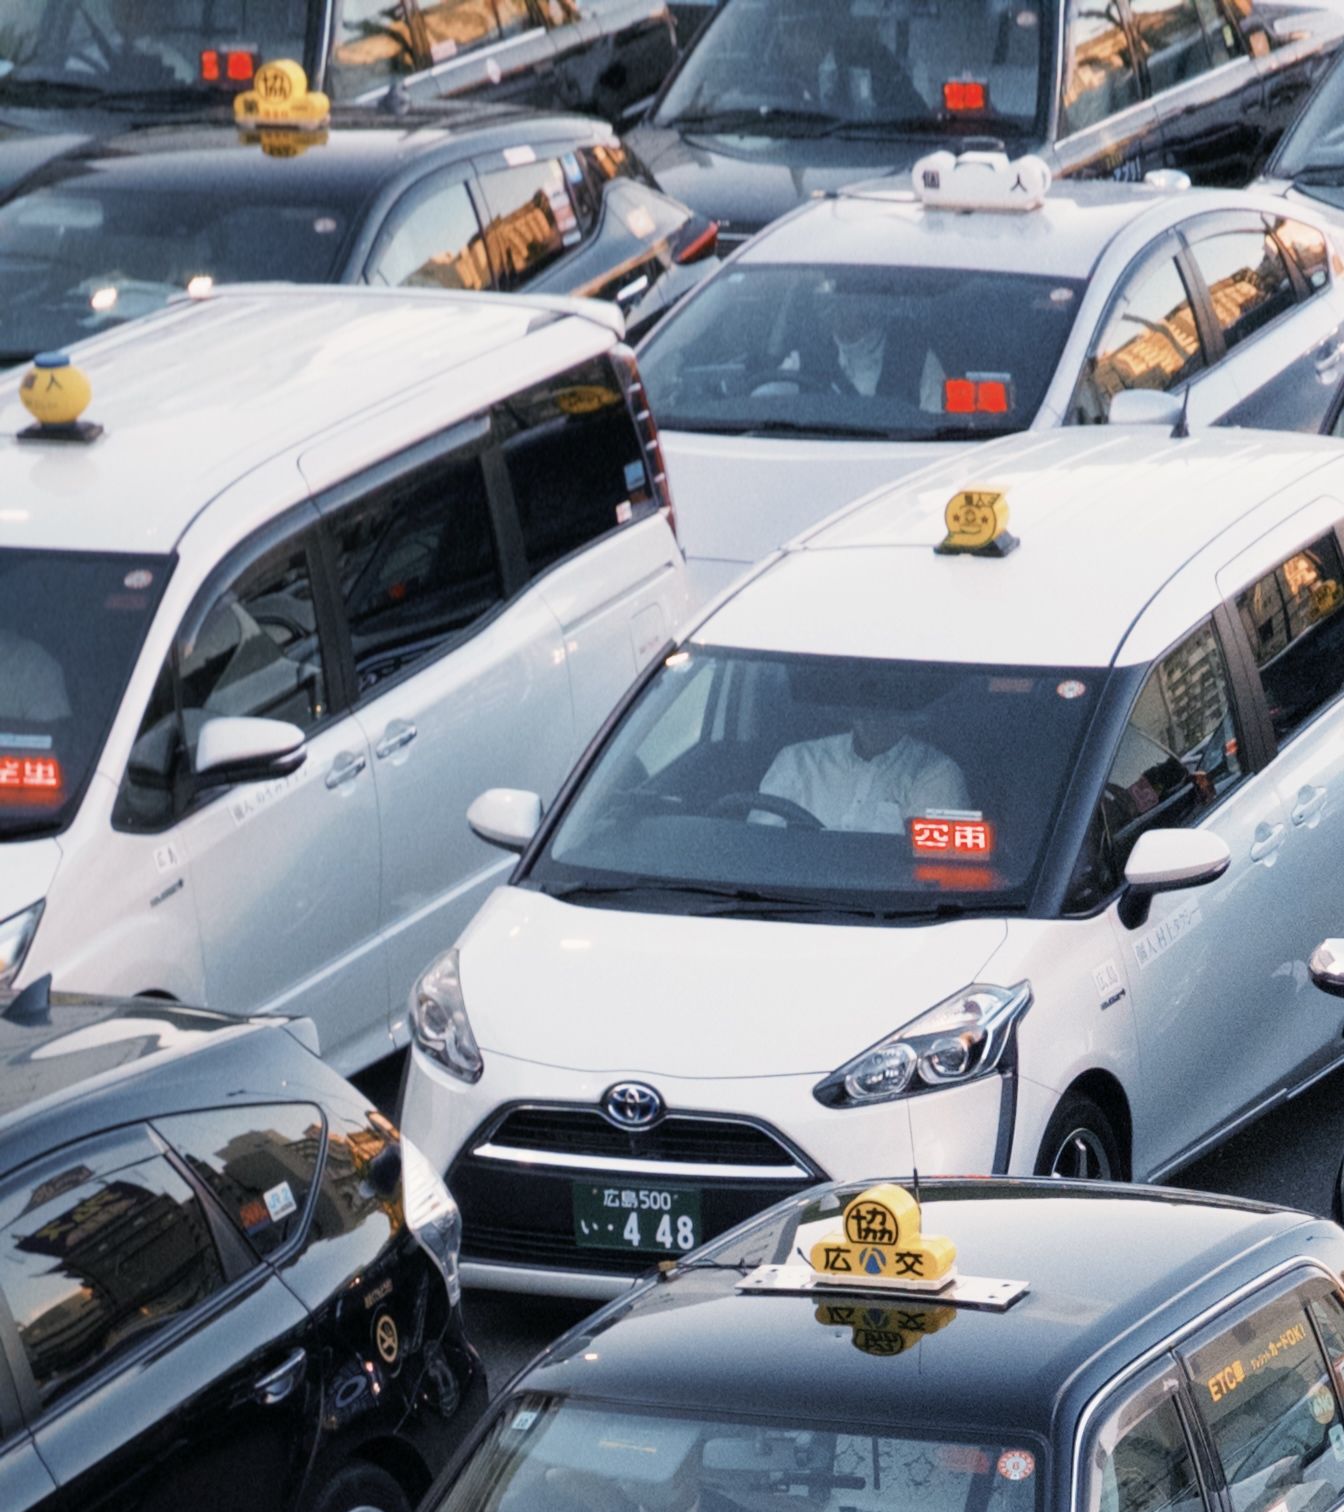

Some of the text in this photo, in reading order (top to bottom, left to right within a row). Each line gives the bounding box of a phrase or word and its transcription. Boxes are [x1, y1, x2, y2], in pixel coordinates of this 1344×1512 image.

[603, 1189, 672, 1210] 広島500
[851, 1207, 893, 1242] 協
[824, 1247, 924, 1277] 広 交
